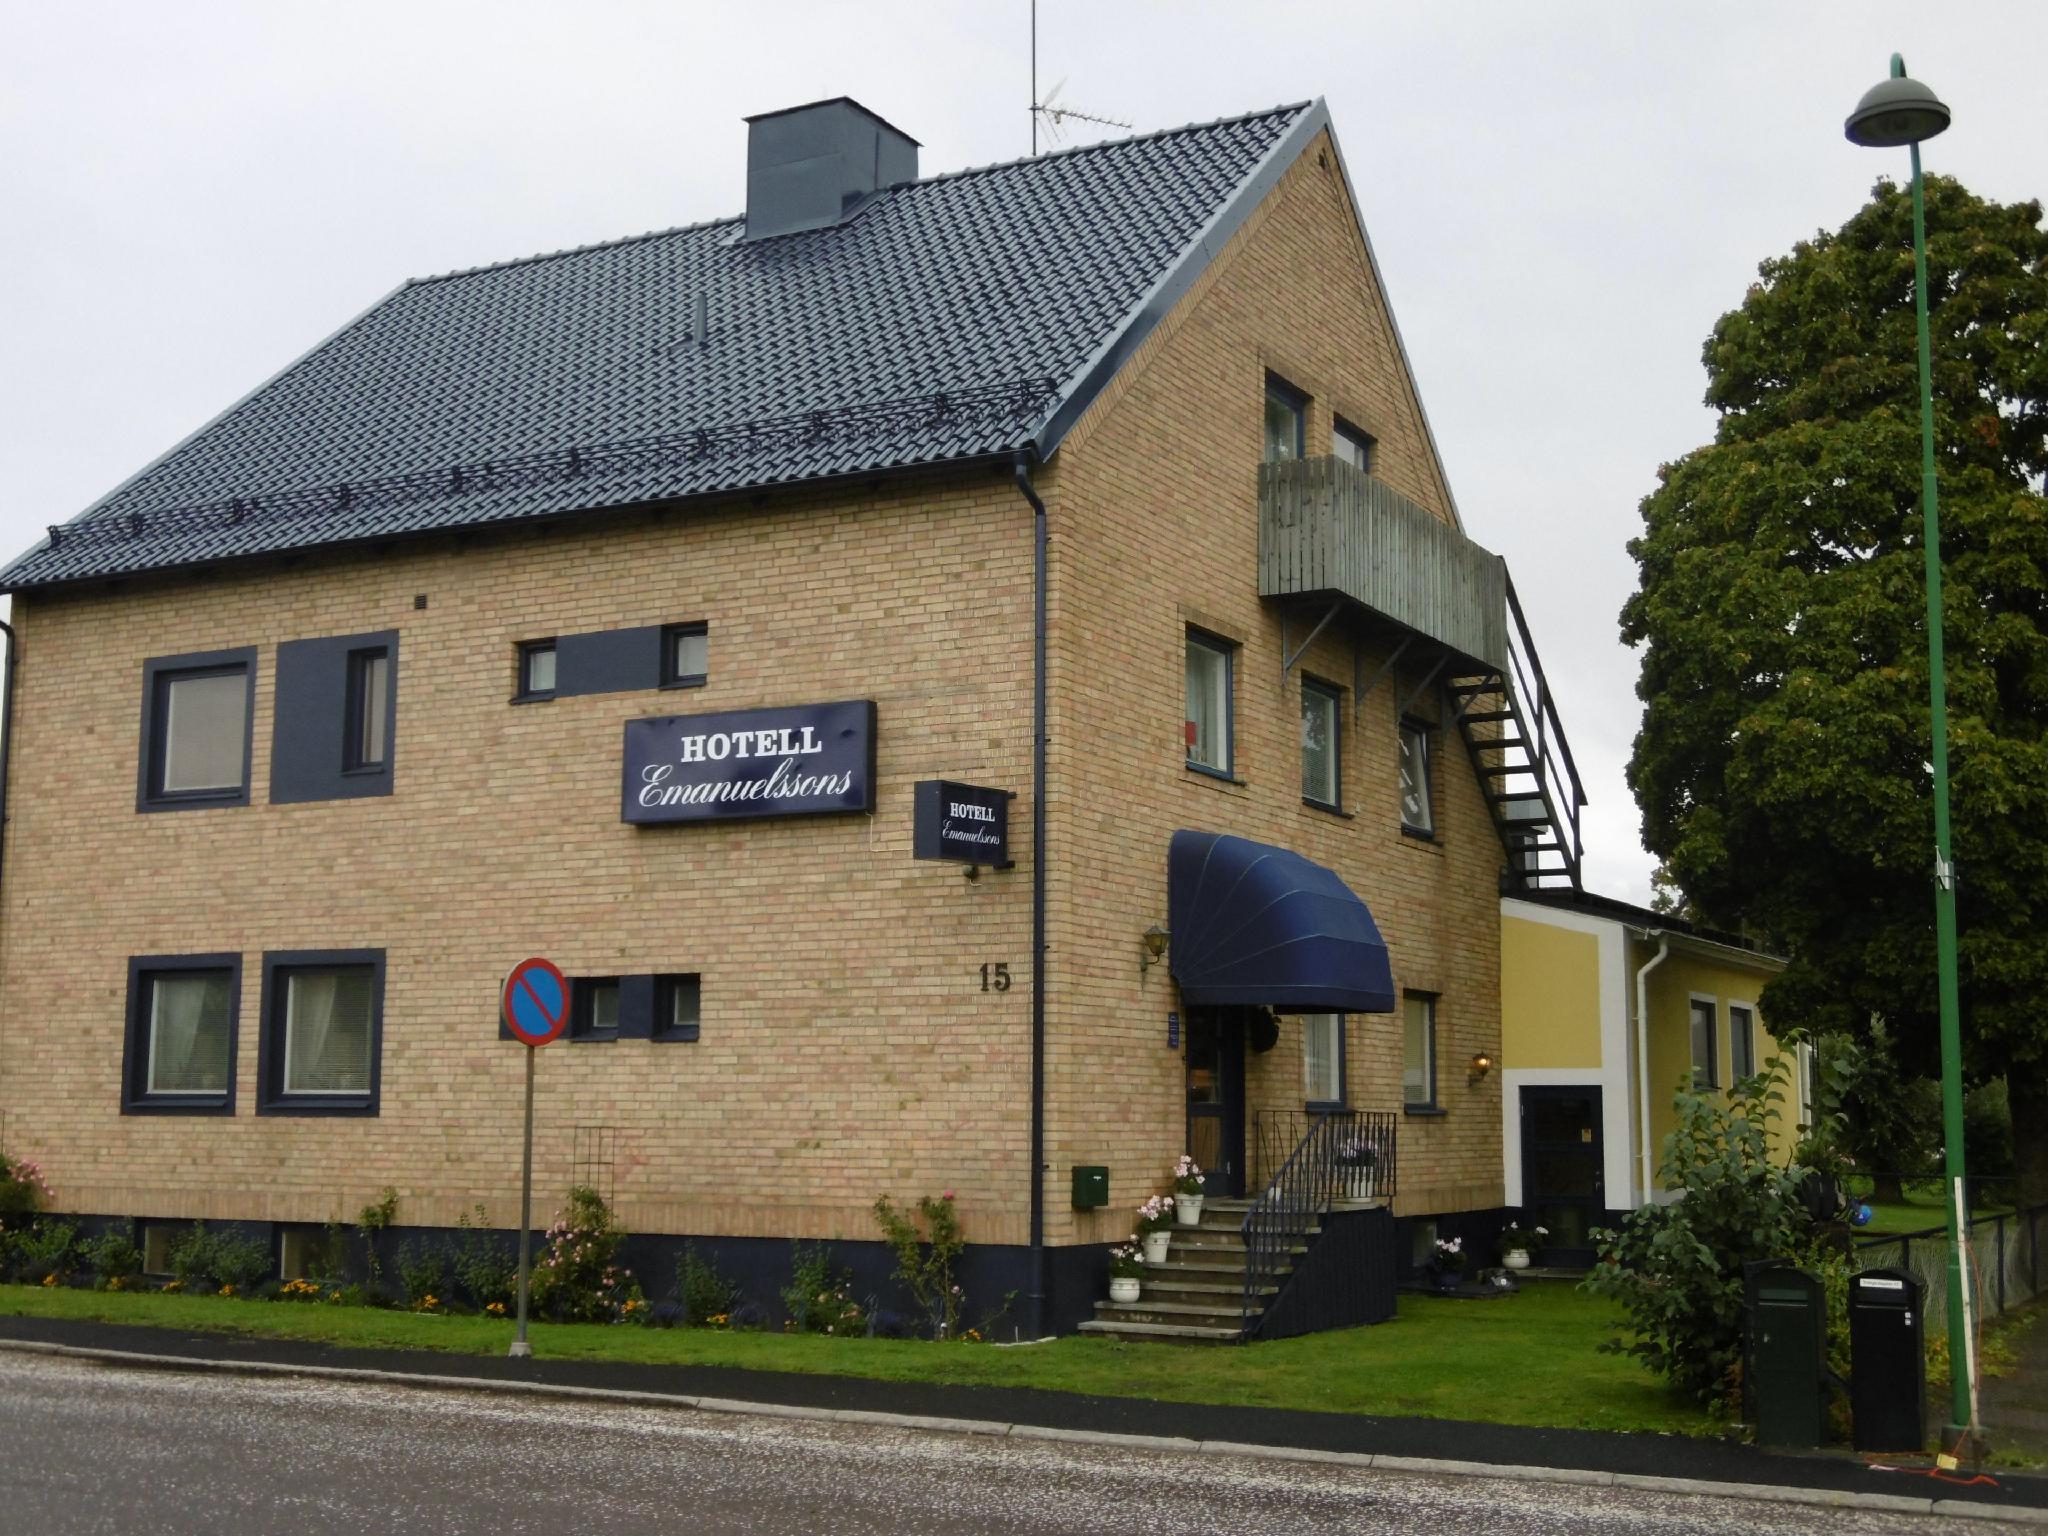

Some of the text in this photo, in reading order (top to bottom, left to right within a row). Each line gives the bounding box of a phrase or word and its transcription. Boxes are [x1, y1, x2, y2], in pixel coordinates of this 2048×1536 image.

[681, 727, 822, 762] HOTELL
[639, 757, 852, 807] Emanuelssons
[950, 802, 995, 822] HOTELL
[942, 819, 1000, 845] Emanuelssons
[980, 962, 1010, 992] 15
